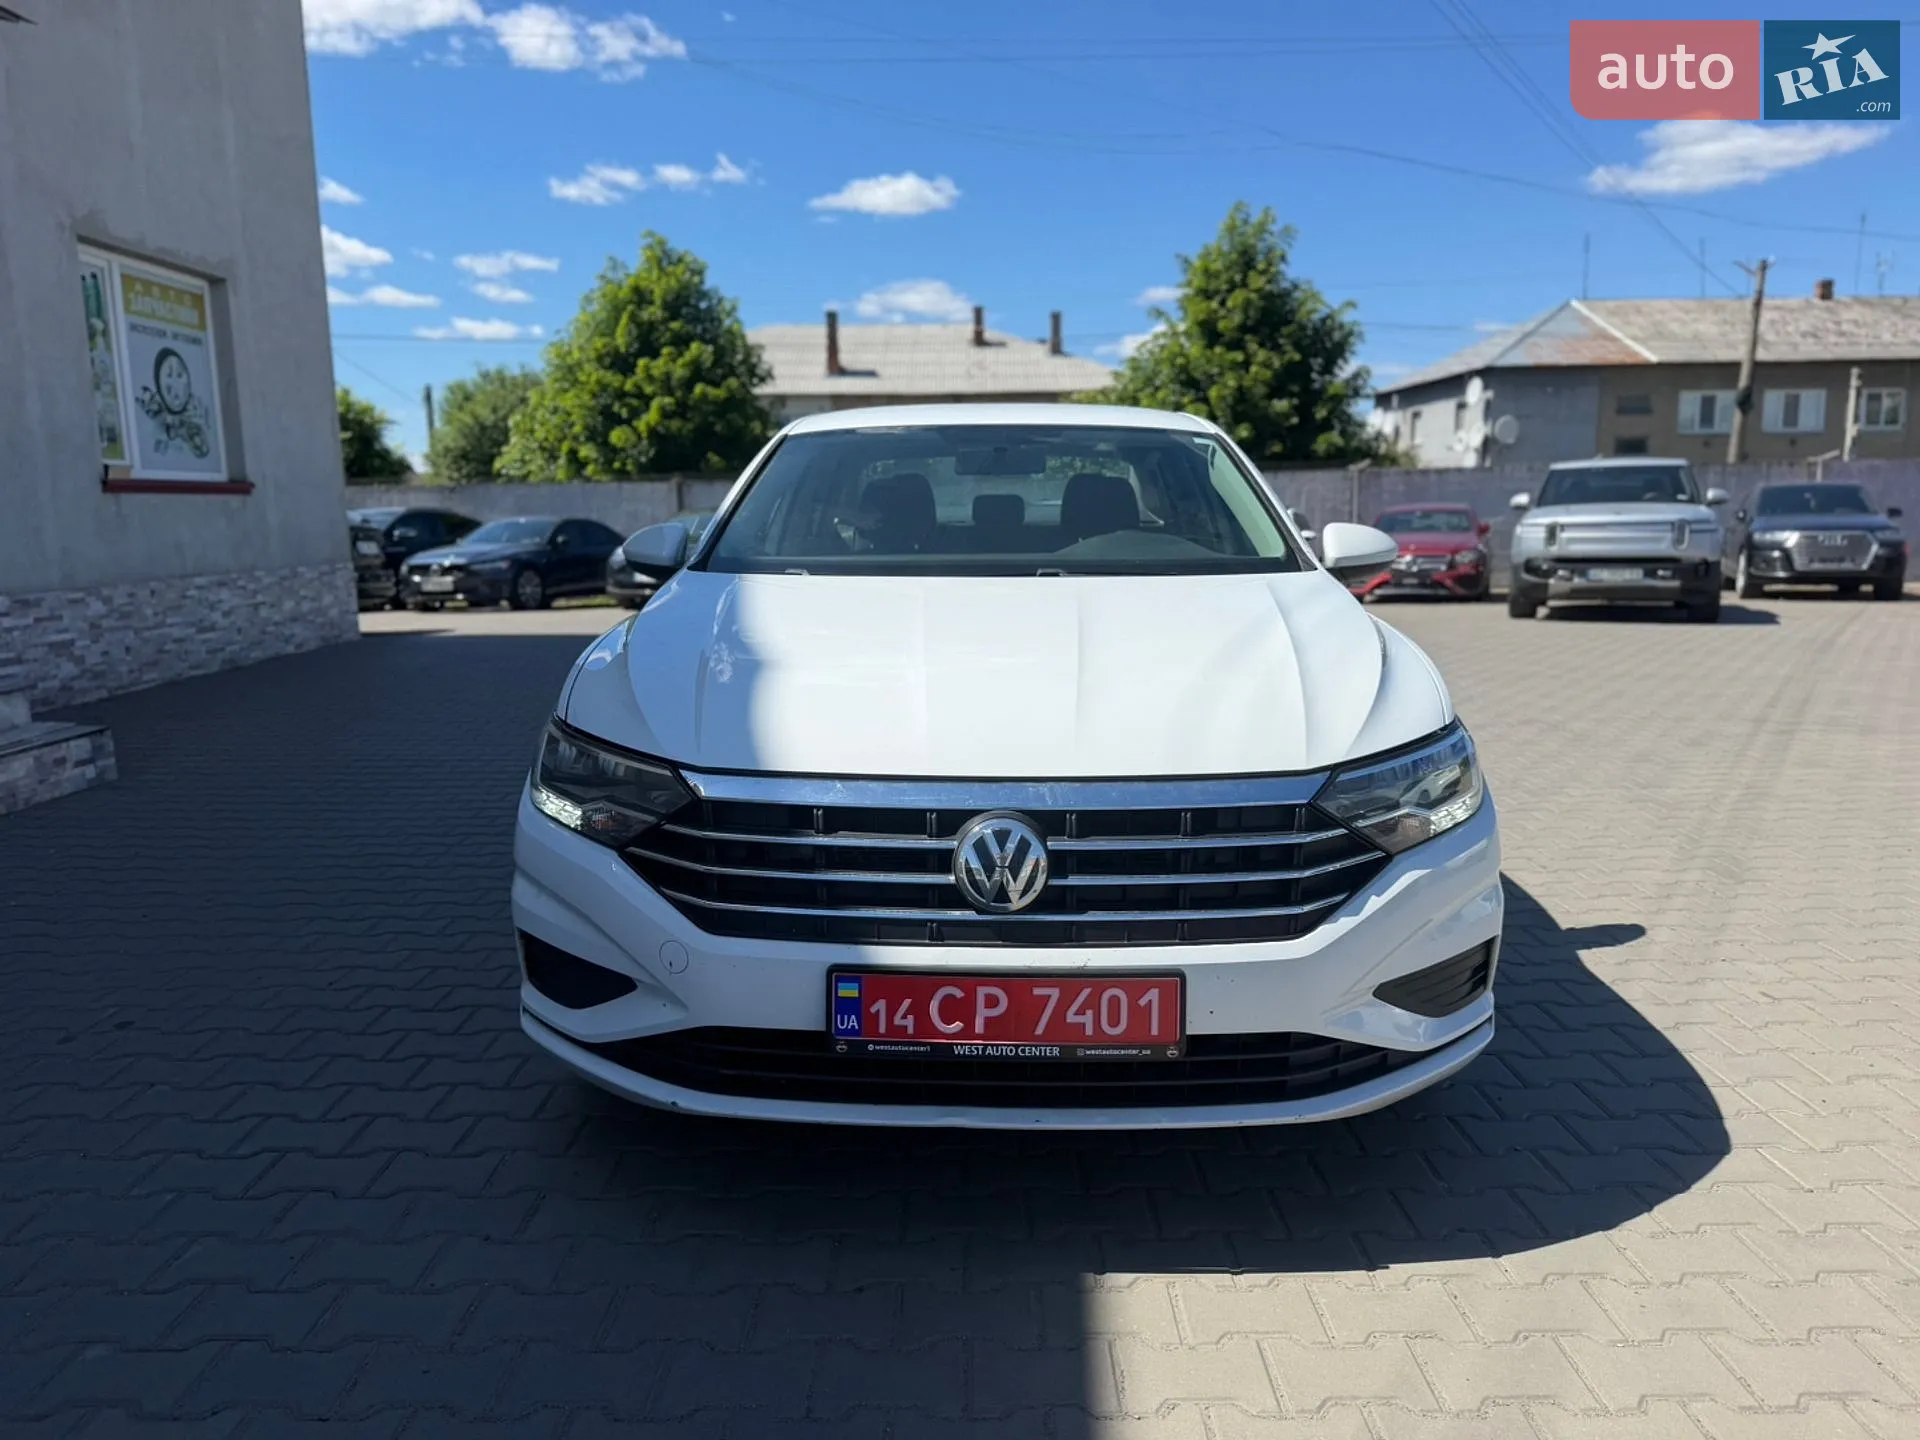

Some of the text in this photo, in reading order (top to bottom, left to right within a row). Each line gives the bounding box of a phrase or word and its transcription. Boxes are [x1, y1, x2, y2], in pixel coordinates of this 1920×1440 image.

[869, 986, 1160, 1036] 14 CP 7401
[837, 1014, 859, 1029] UA
[953, 1045, 1060, 1056] WEST AUTO CENTER
